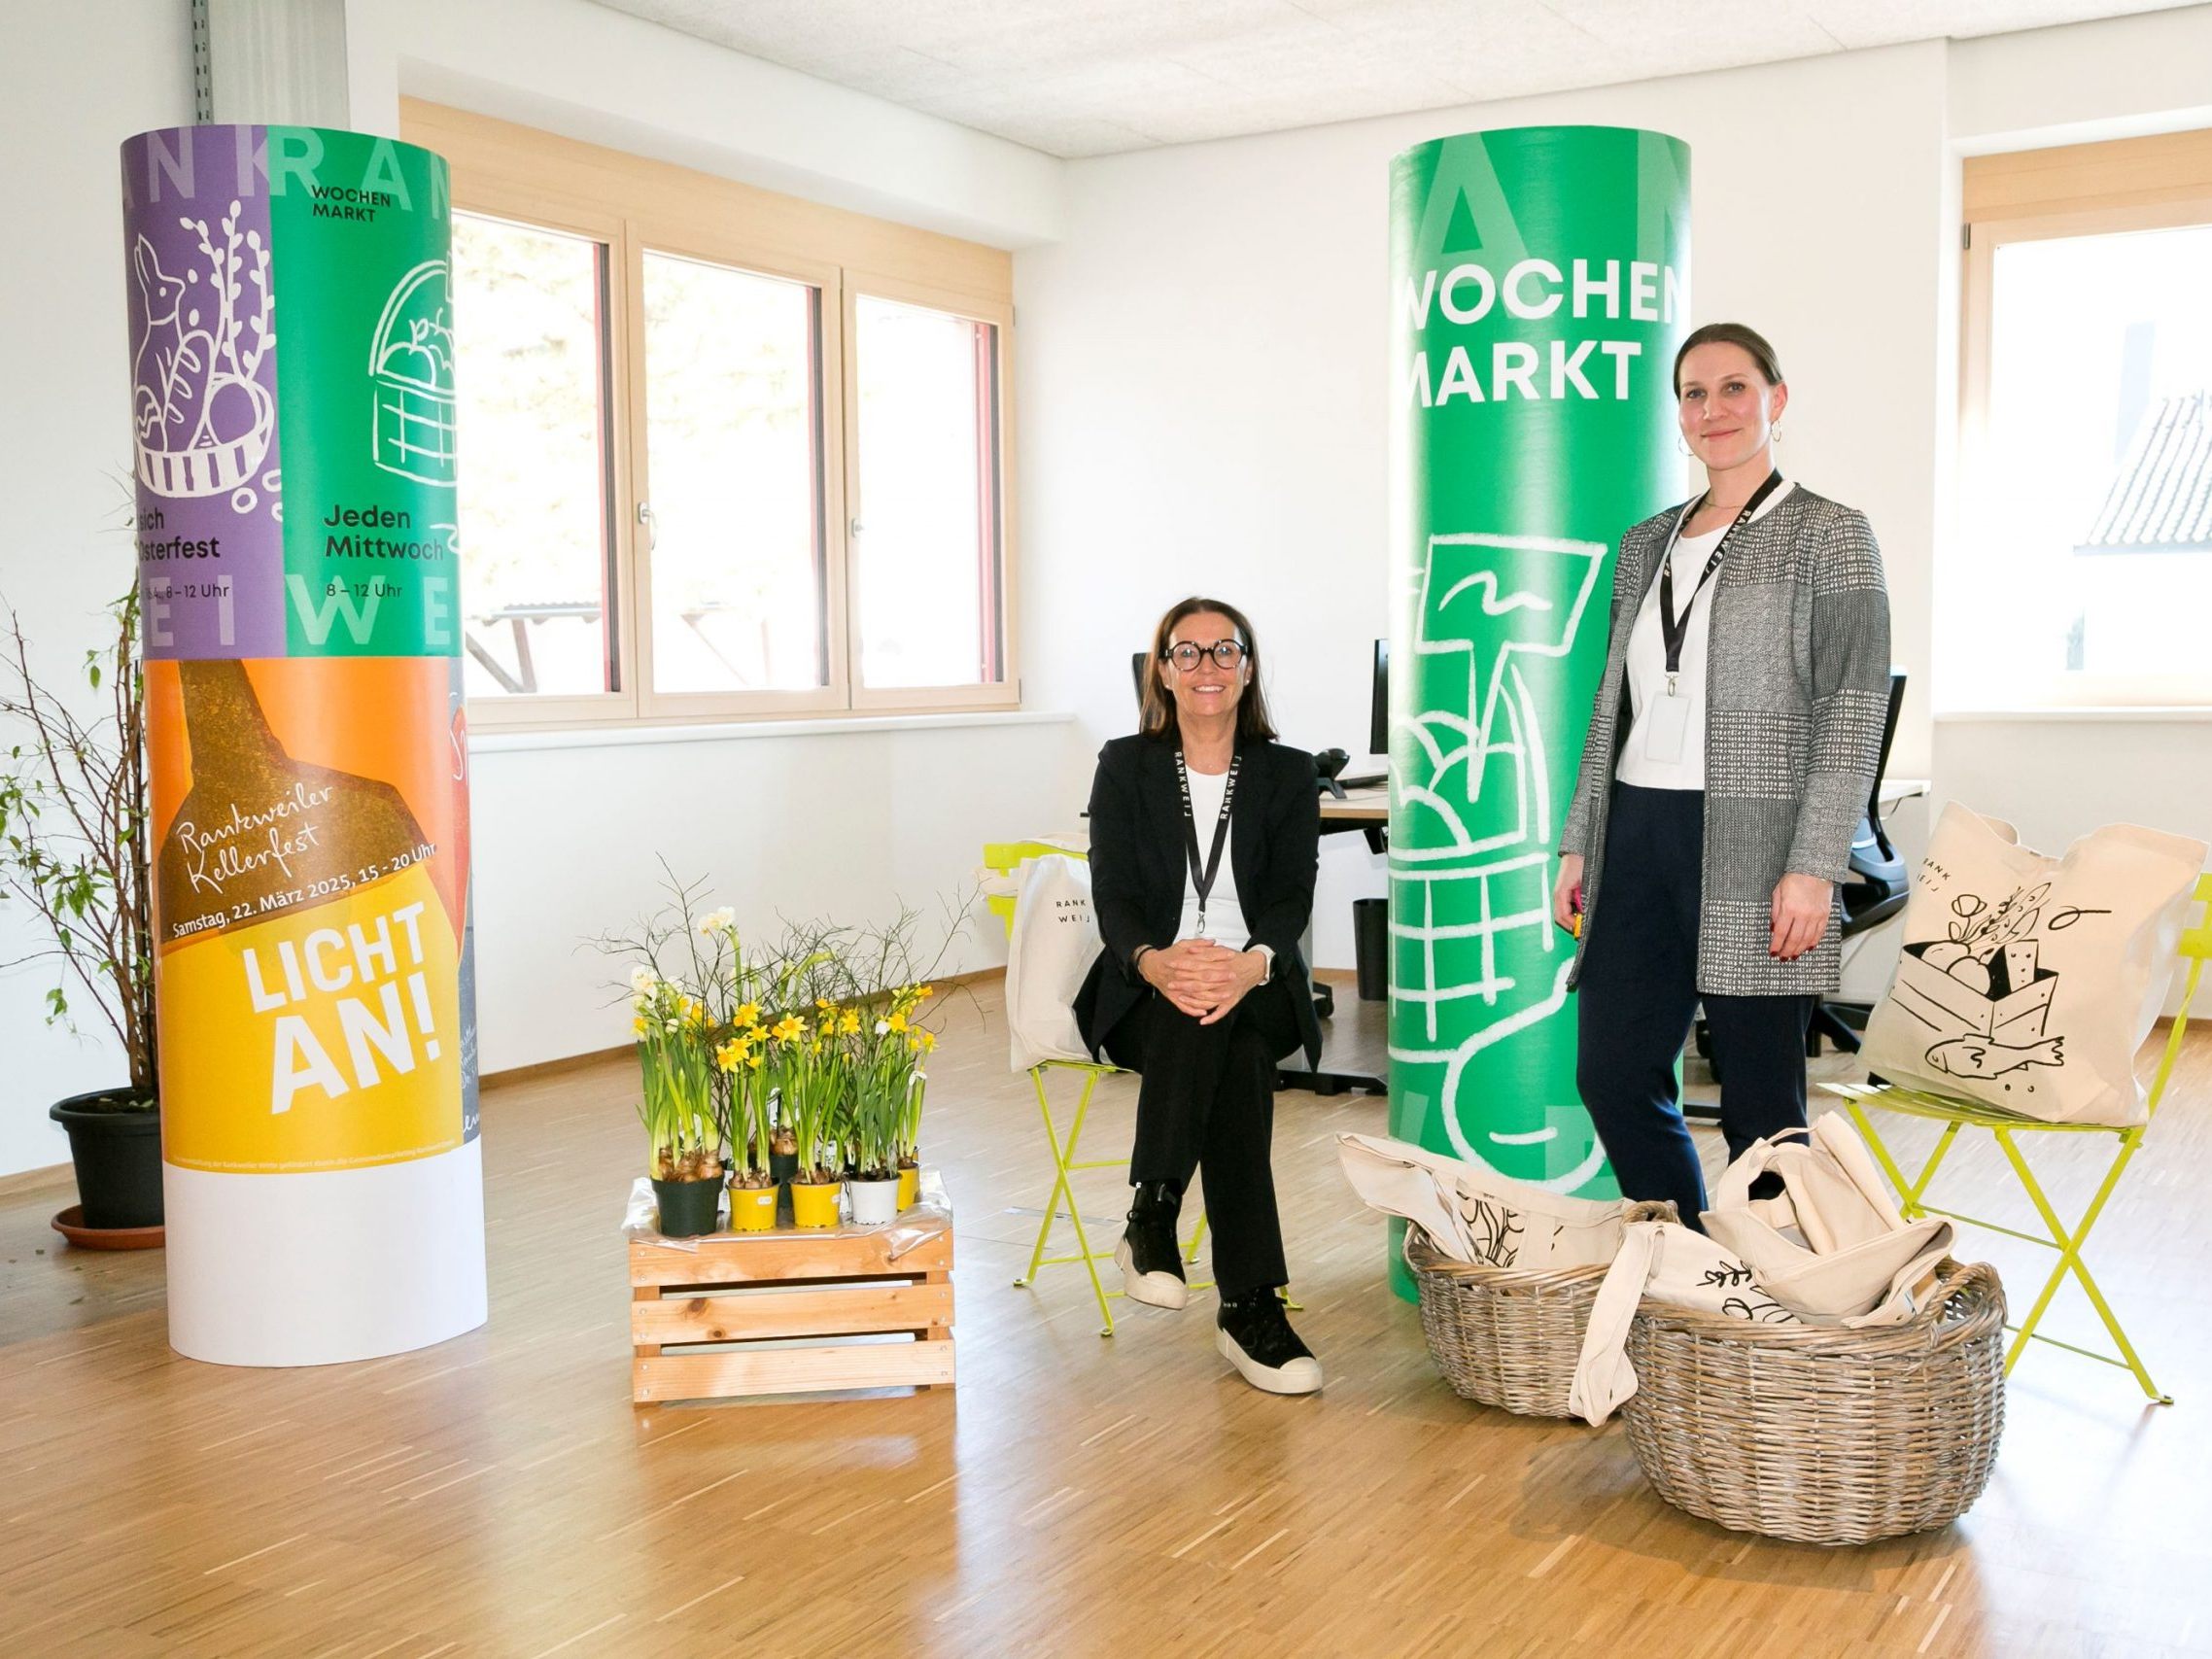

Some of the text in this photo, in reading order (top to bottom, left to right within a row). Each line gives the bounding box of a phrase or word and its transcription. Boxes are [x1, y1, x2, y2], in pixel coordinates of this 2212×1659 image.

[311, 185, 391, 207] WOCHEN
[312, 203, 375, 223] MARKT
[325, 504, 411, 529] Jeden
[325, 536, 443, 561] Mittwoch
[201, 584, 229, 597] Uhr
[375, 583, 402, 598] Uhr
[176, 782, 333, 854] Rankweiler
[187, 822, 319, 894] Kellerfest
[173, 912, 230, 938] Samstag,
[232, 902, 257, 919] 22.
[259, 890, 304, 910] März
[309, 874, 357, 896] 2025,
[360, 865, 379, 881] 15
[392, 857, 409, 871] 20
[413, 843, 436, 862] Uhr
[1055, 899, 1087, 908] RANK
[242, 901, 425, 1014] LICHT
[271, 971, 441, 1116] AN!
